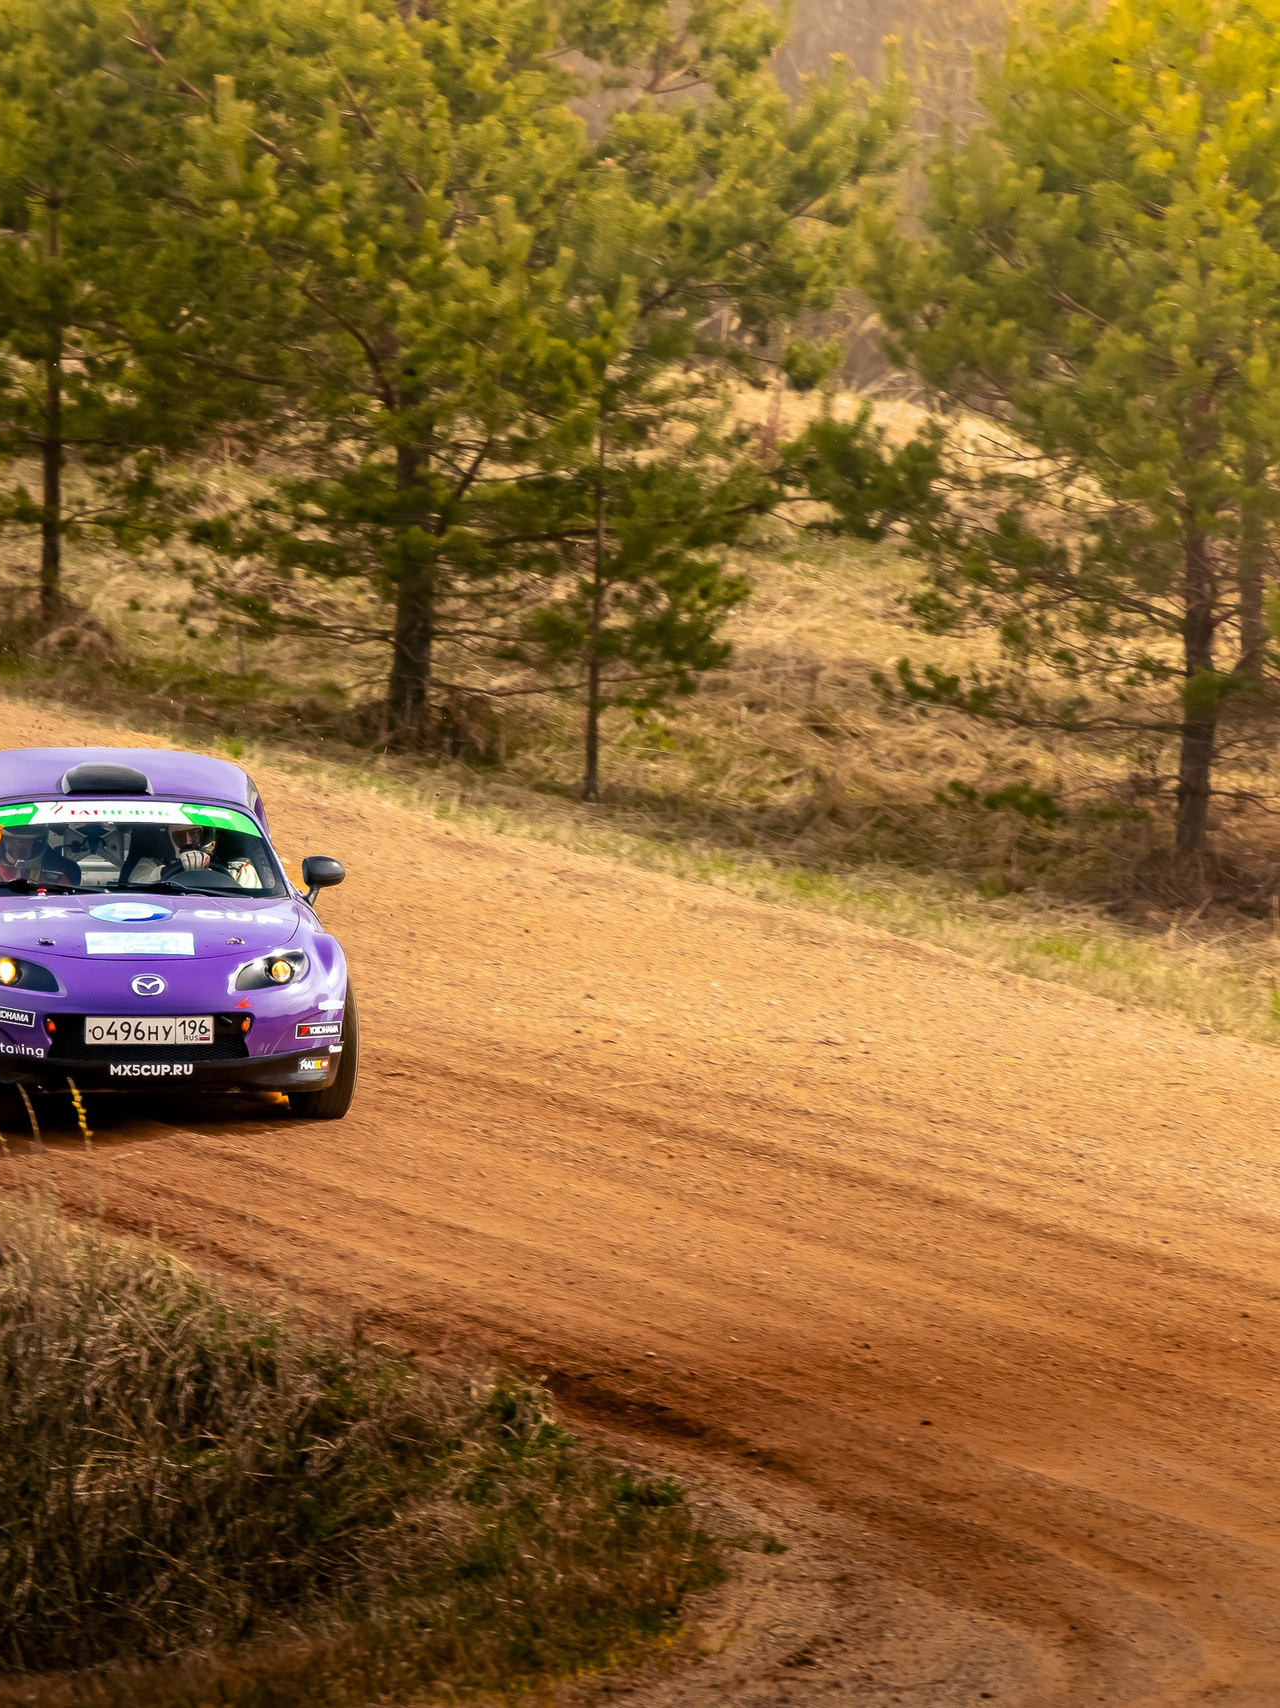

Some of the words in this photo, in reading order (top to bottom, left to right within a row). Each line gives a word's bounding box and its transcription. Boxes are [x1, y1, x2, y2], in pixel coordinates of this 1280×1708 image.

[3, 908, 70, 923] MX
[117, 904, 155, 919] 5
[193, 909, 284, 924] CUP
[178, 1019, 207, 1034] 196
[309, 1024, 339, 1034] YOKOHAMA
[110, 1064, 194, 1076] MX5CUP.RU
